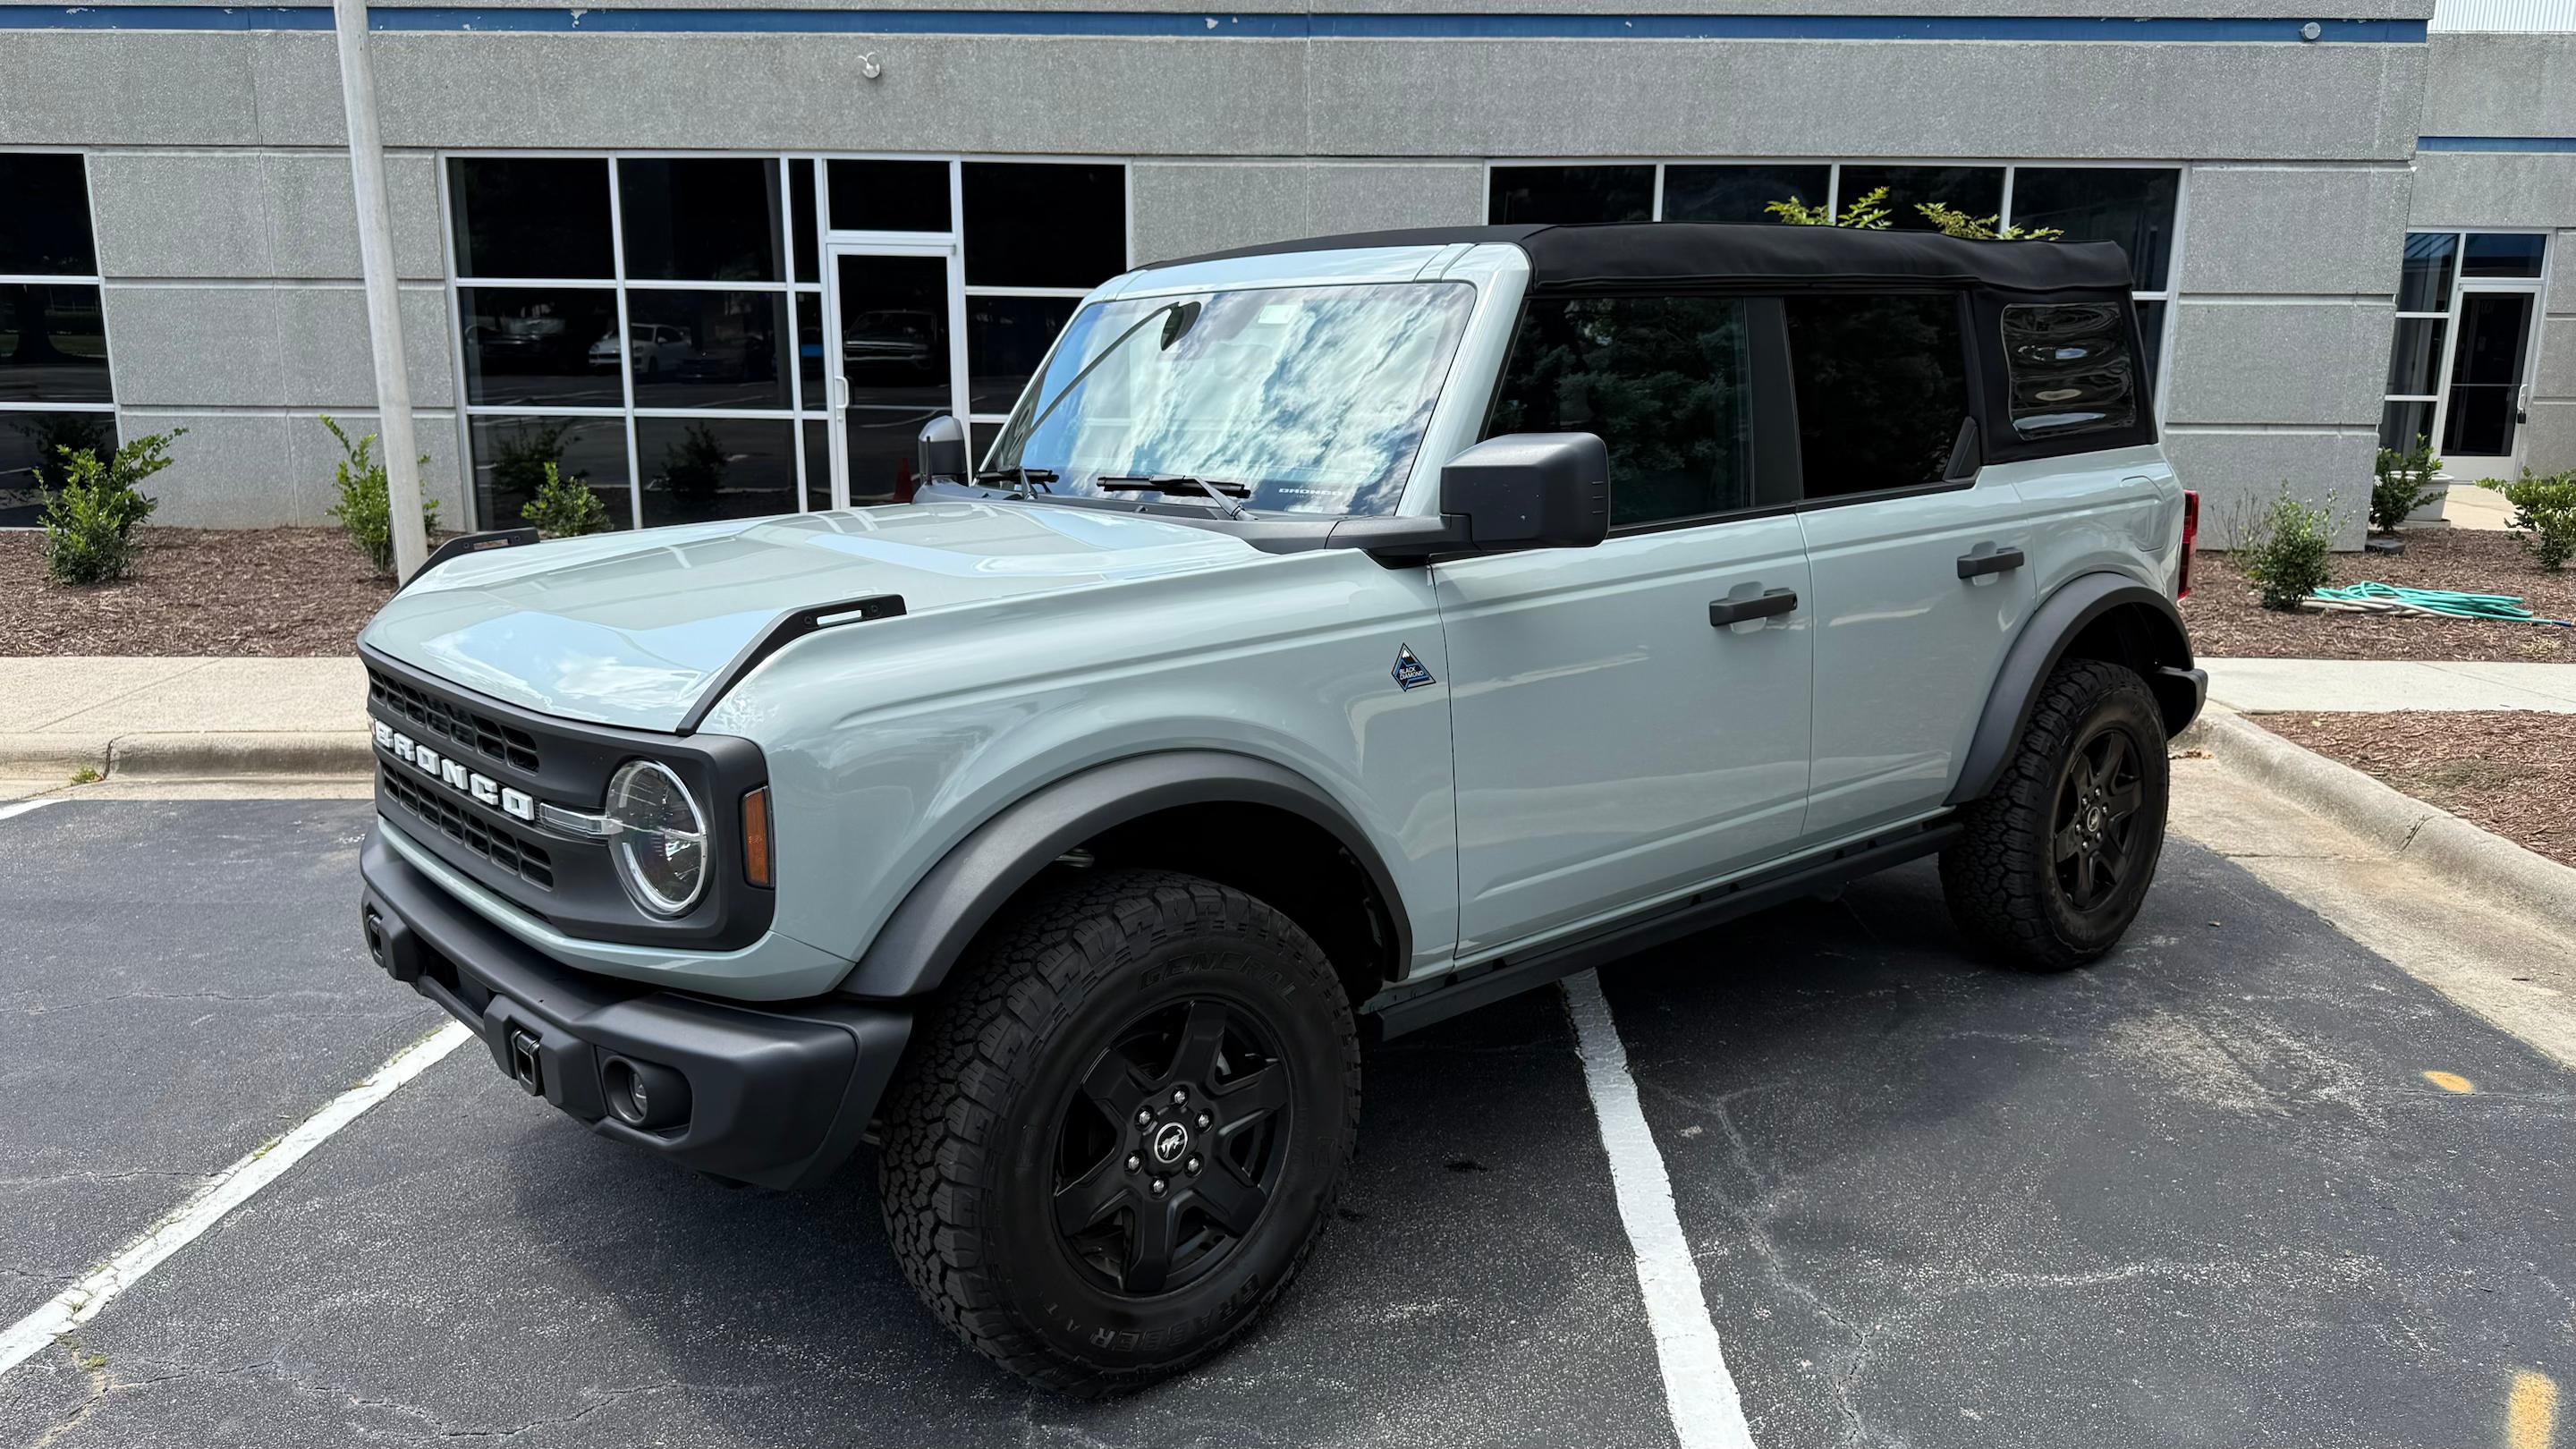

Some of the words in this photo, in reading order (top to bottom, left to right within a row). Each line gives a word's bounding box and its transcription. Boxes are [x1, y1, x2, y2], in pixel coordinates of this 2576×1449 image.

[1399, 671, 1425, 681] DIAMOND
[1400, 666, 1417, 674] BLACK
[375, 720, 536, 821] BRONCO
[1137, 951, 1298, 1009] GENERAL
